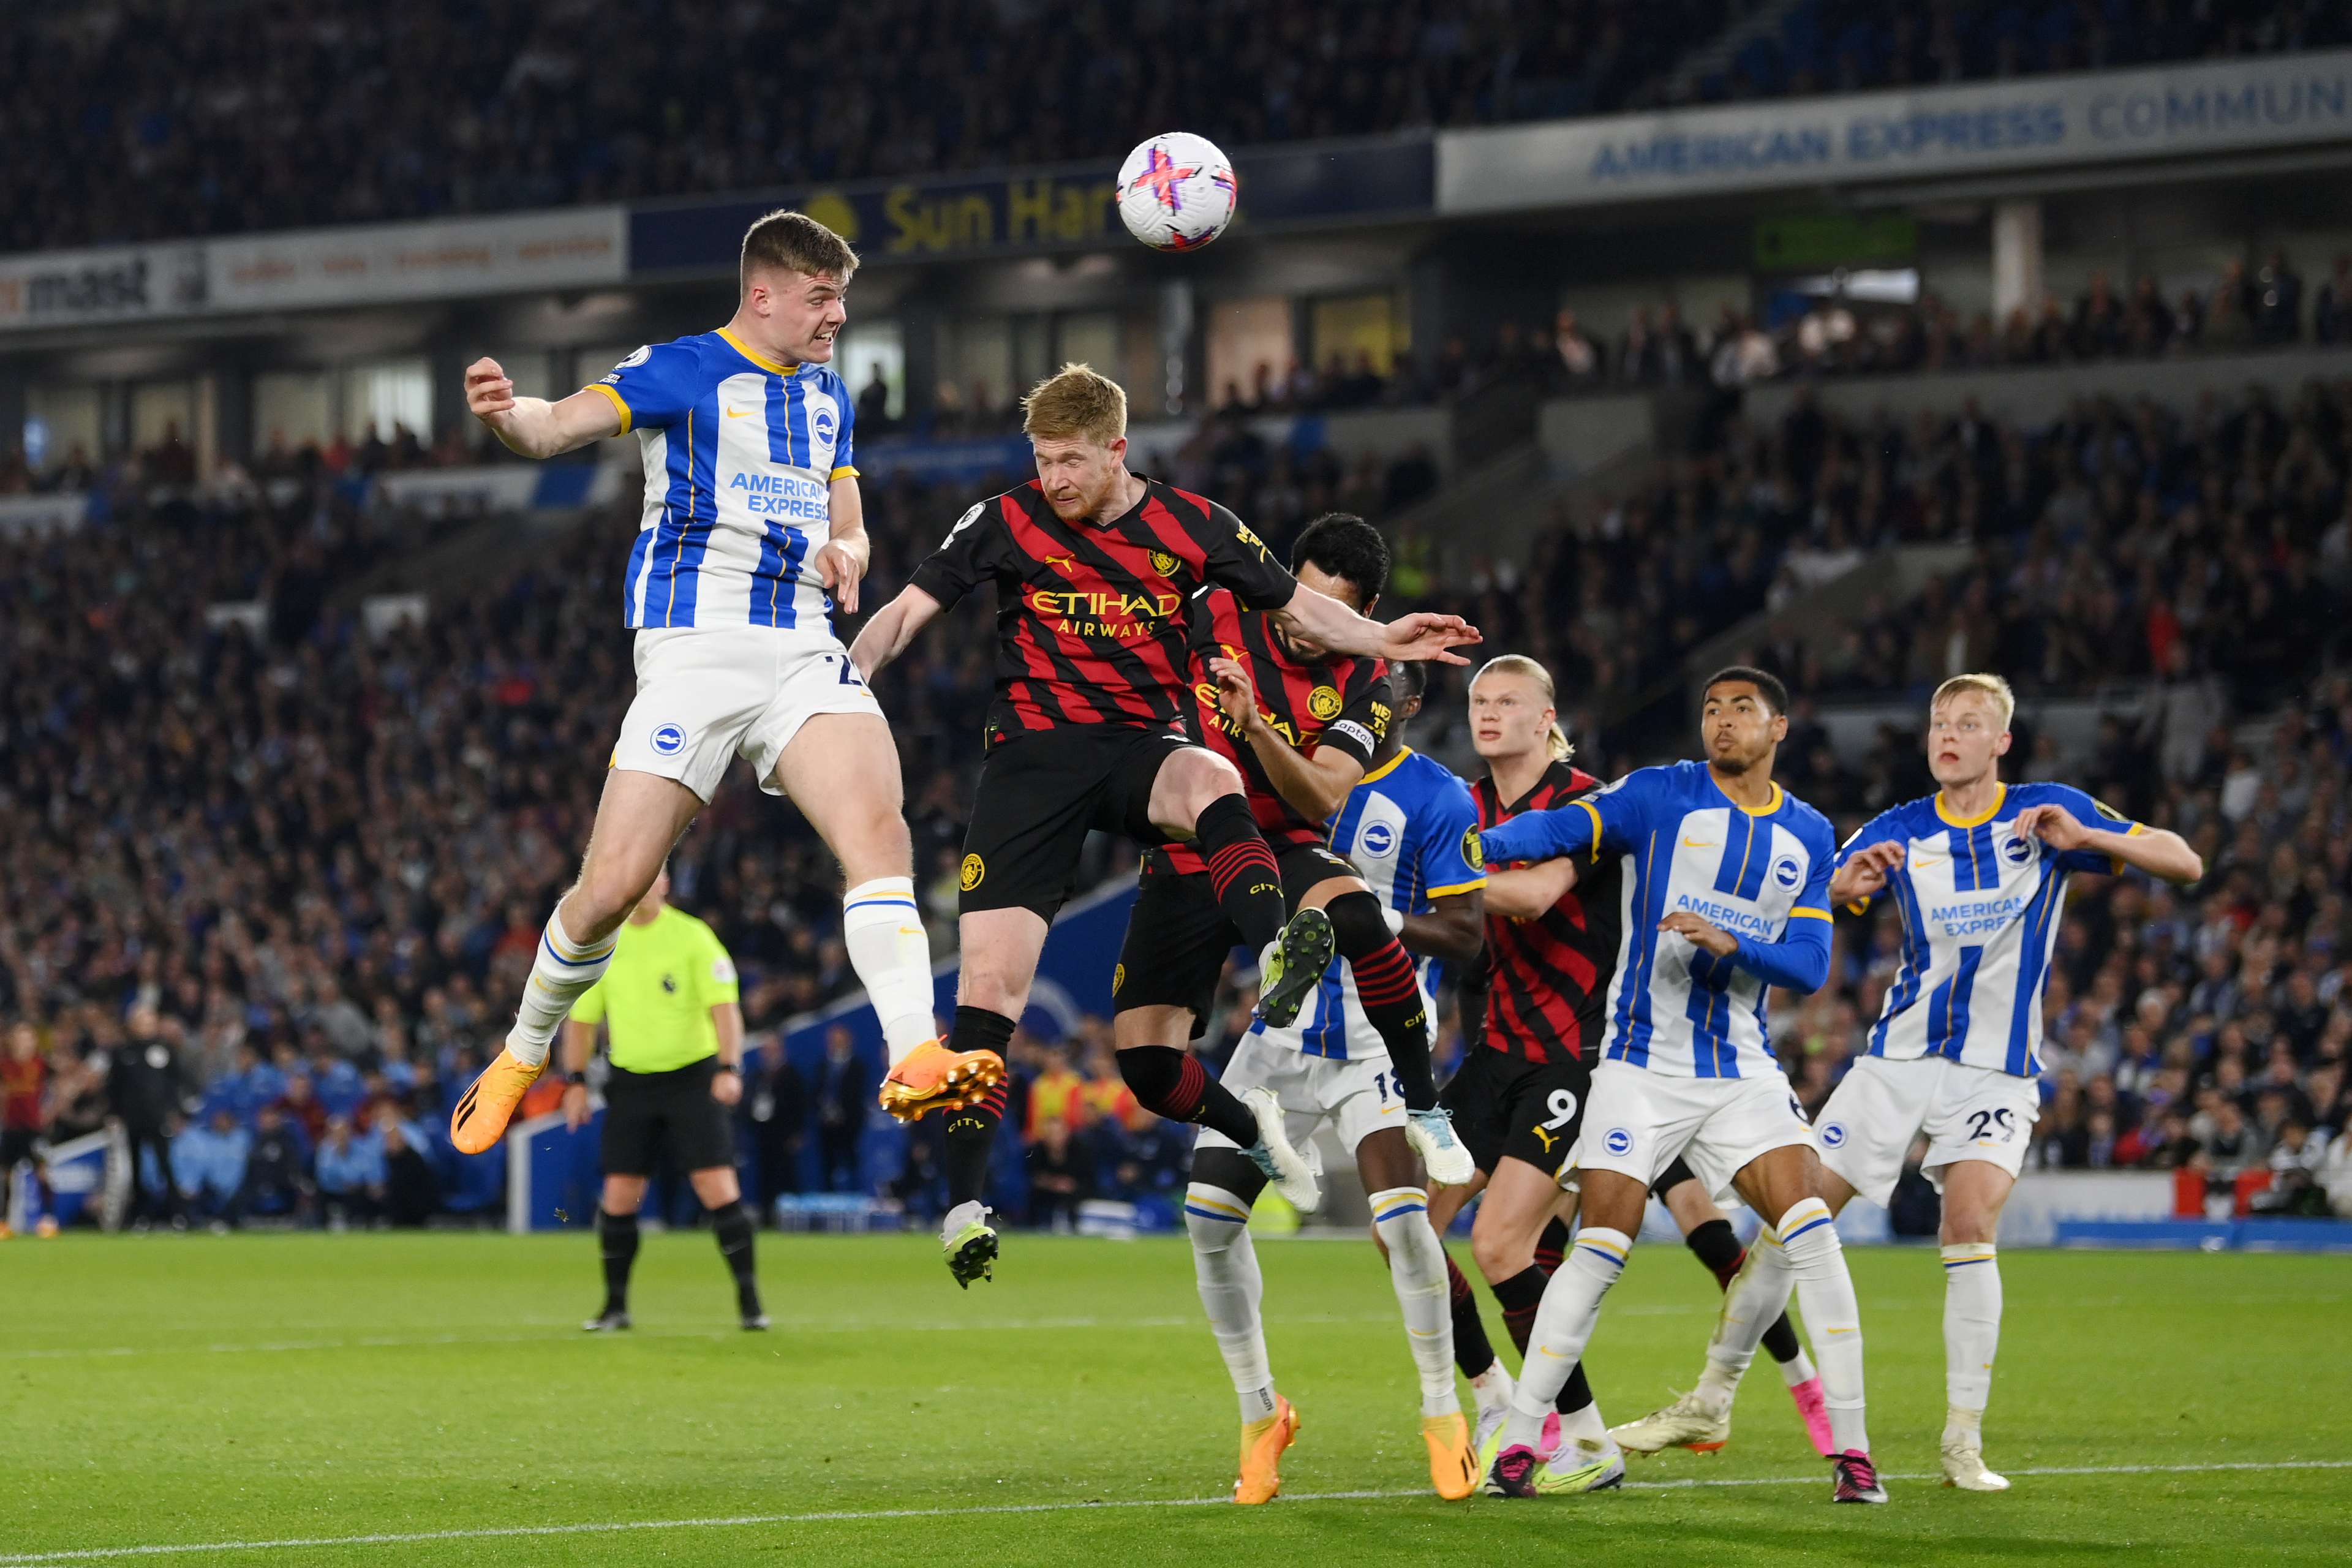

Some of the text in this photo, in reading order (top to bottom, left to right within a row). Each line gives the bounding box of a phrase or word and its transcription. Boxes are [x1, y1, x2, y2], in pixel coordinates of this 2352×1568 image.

[1594, 124, 1831, 180] AMERICAN
[1846, 100, 2065, 160] EXPRESS
[884, 175, 1117, 252] Sun Har
[748, 494, 827, 521] EXPRESS
[1032, 590, 1181, 617] ETIHAD
[1057, 618, 1156, 638] AIRWAYS
[824, 655, 866, 687] 2
[1677, 894, 1774, 935] AMERICAN
[1404, 1009, 1425, 1028] CIT
[948, 1117, 985, 1133] CITY
[1540, 1088, 1577, 1131] 9
[1966, 1108, 2015, 1143] 29
